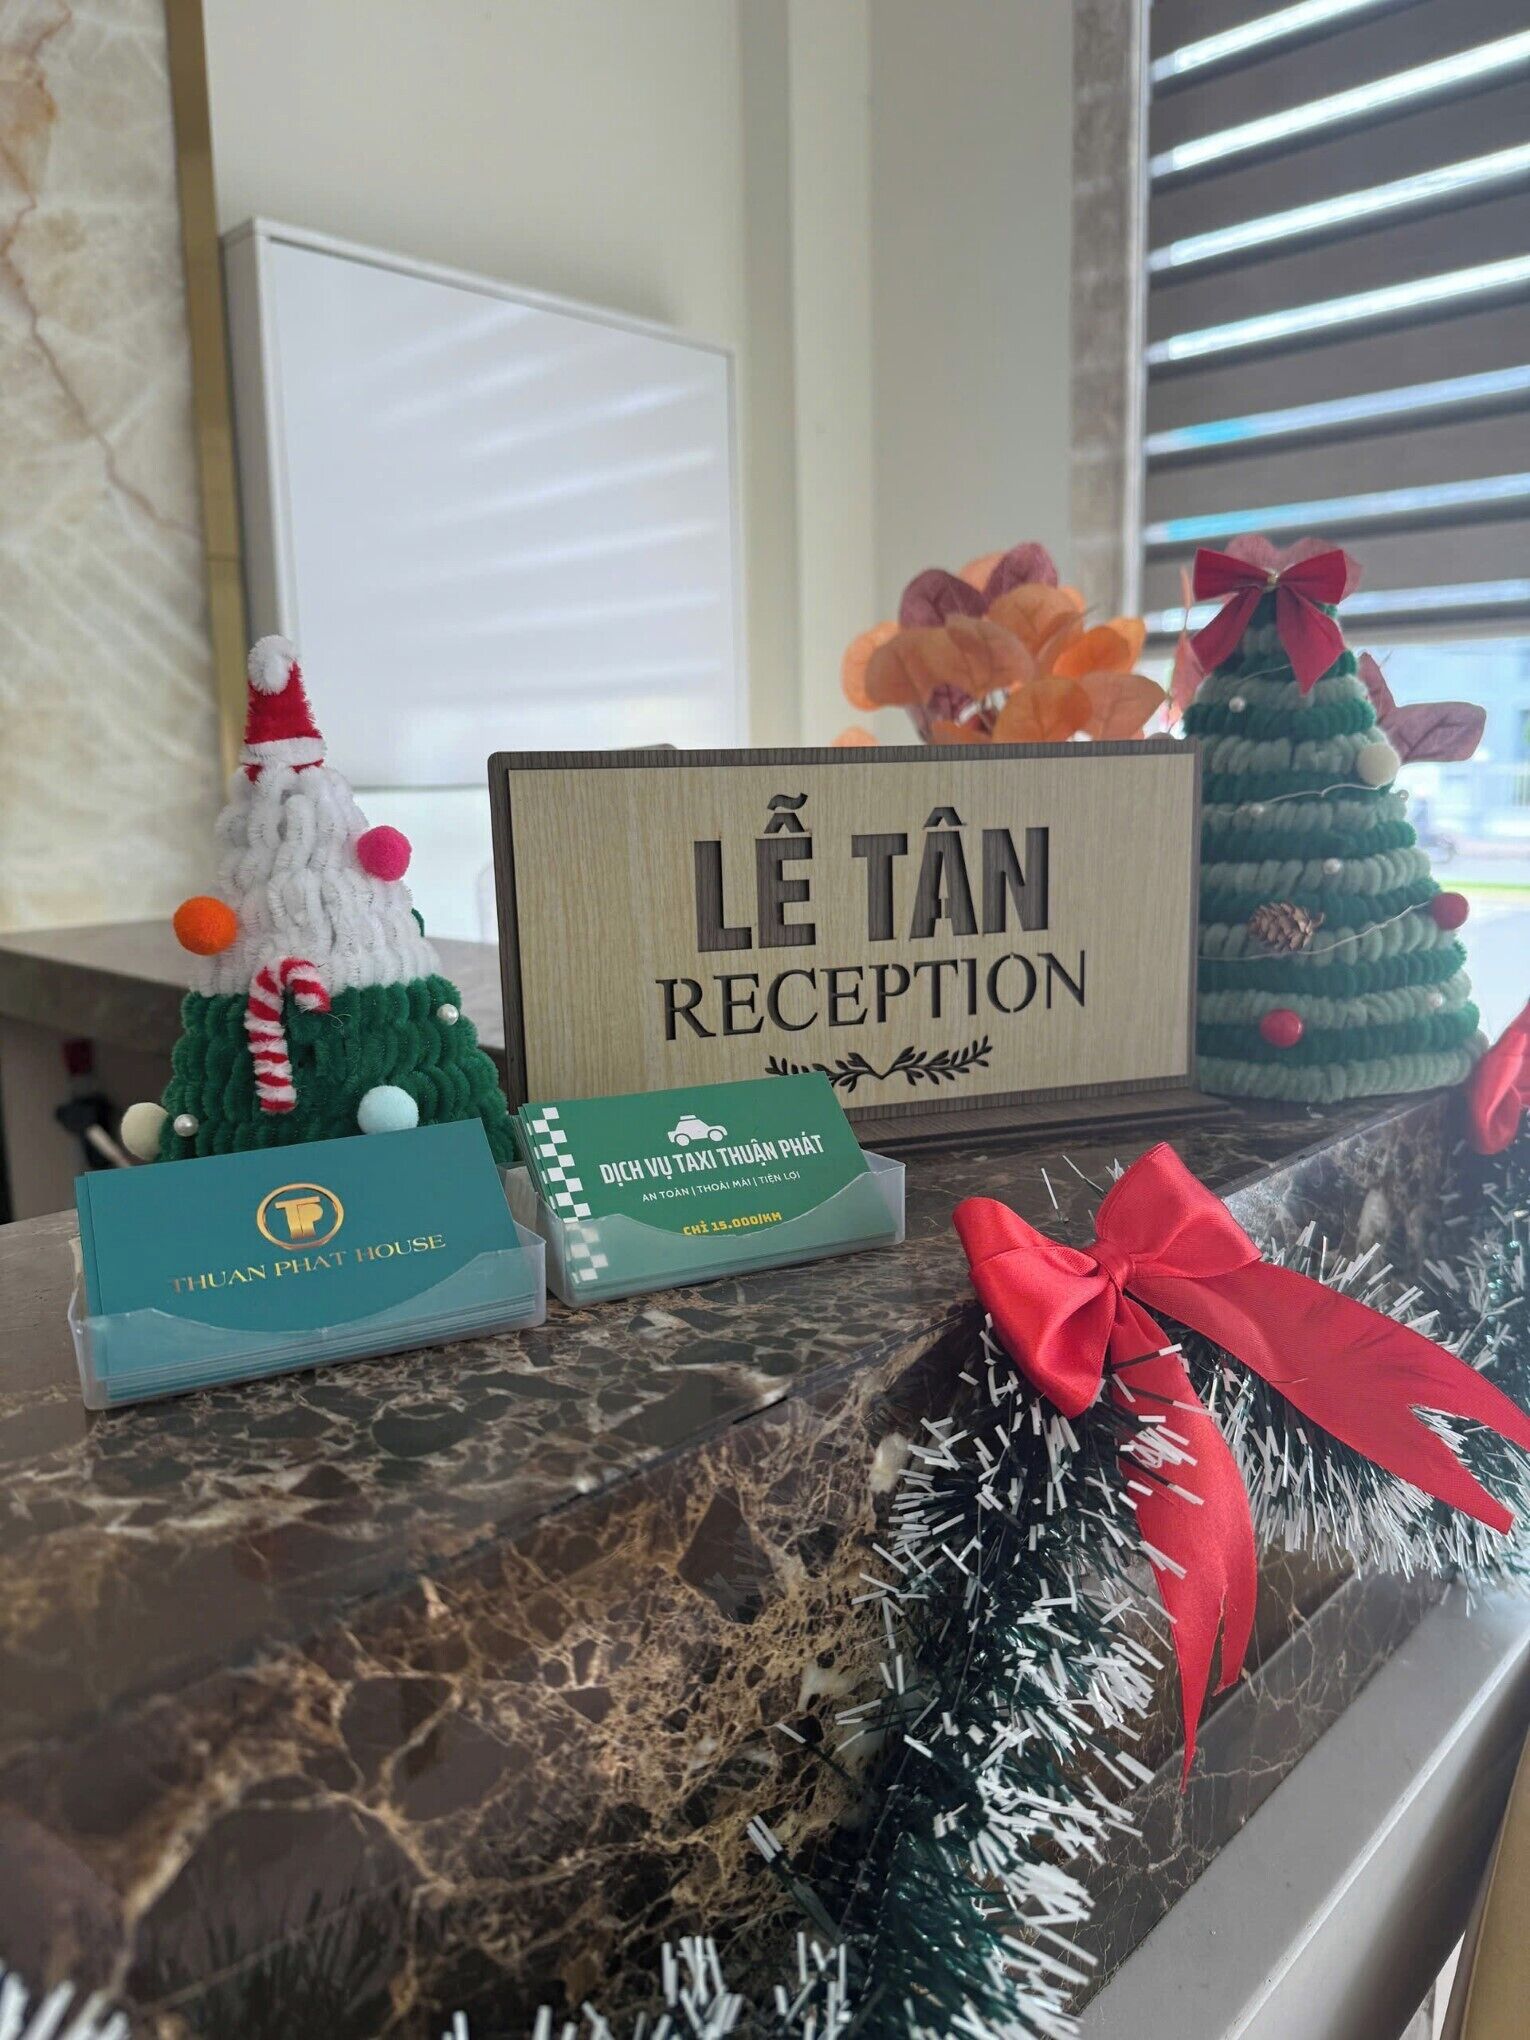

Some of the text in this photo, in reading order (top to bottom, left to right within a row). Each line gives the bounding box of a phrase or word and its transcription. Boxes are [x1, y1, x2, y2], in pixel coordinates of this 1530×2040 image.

[693, 792, 1050, 953] LỄ TÂN
[655, 948, 1087, 1041] RECEPTION
[599, 1131, 824, 1187] DỊCH VỤ TAXI THUẬN PHÁT
[642, 1190, 658, 1203] AN
[170, 1233, 447, 1294] THUAN PHAT HOUSE
